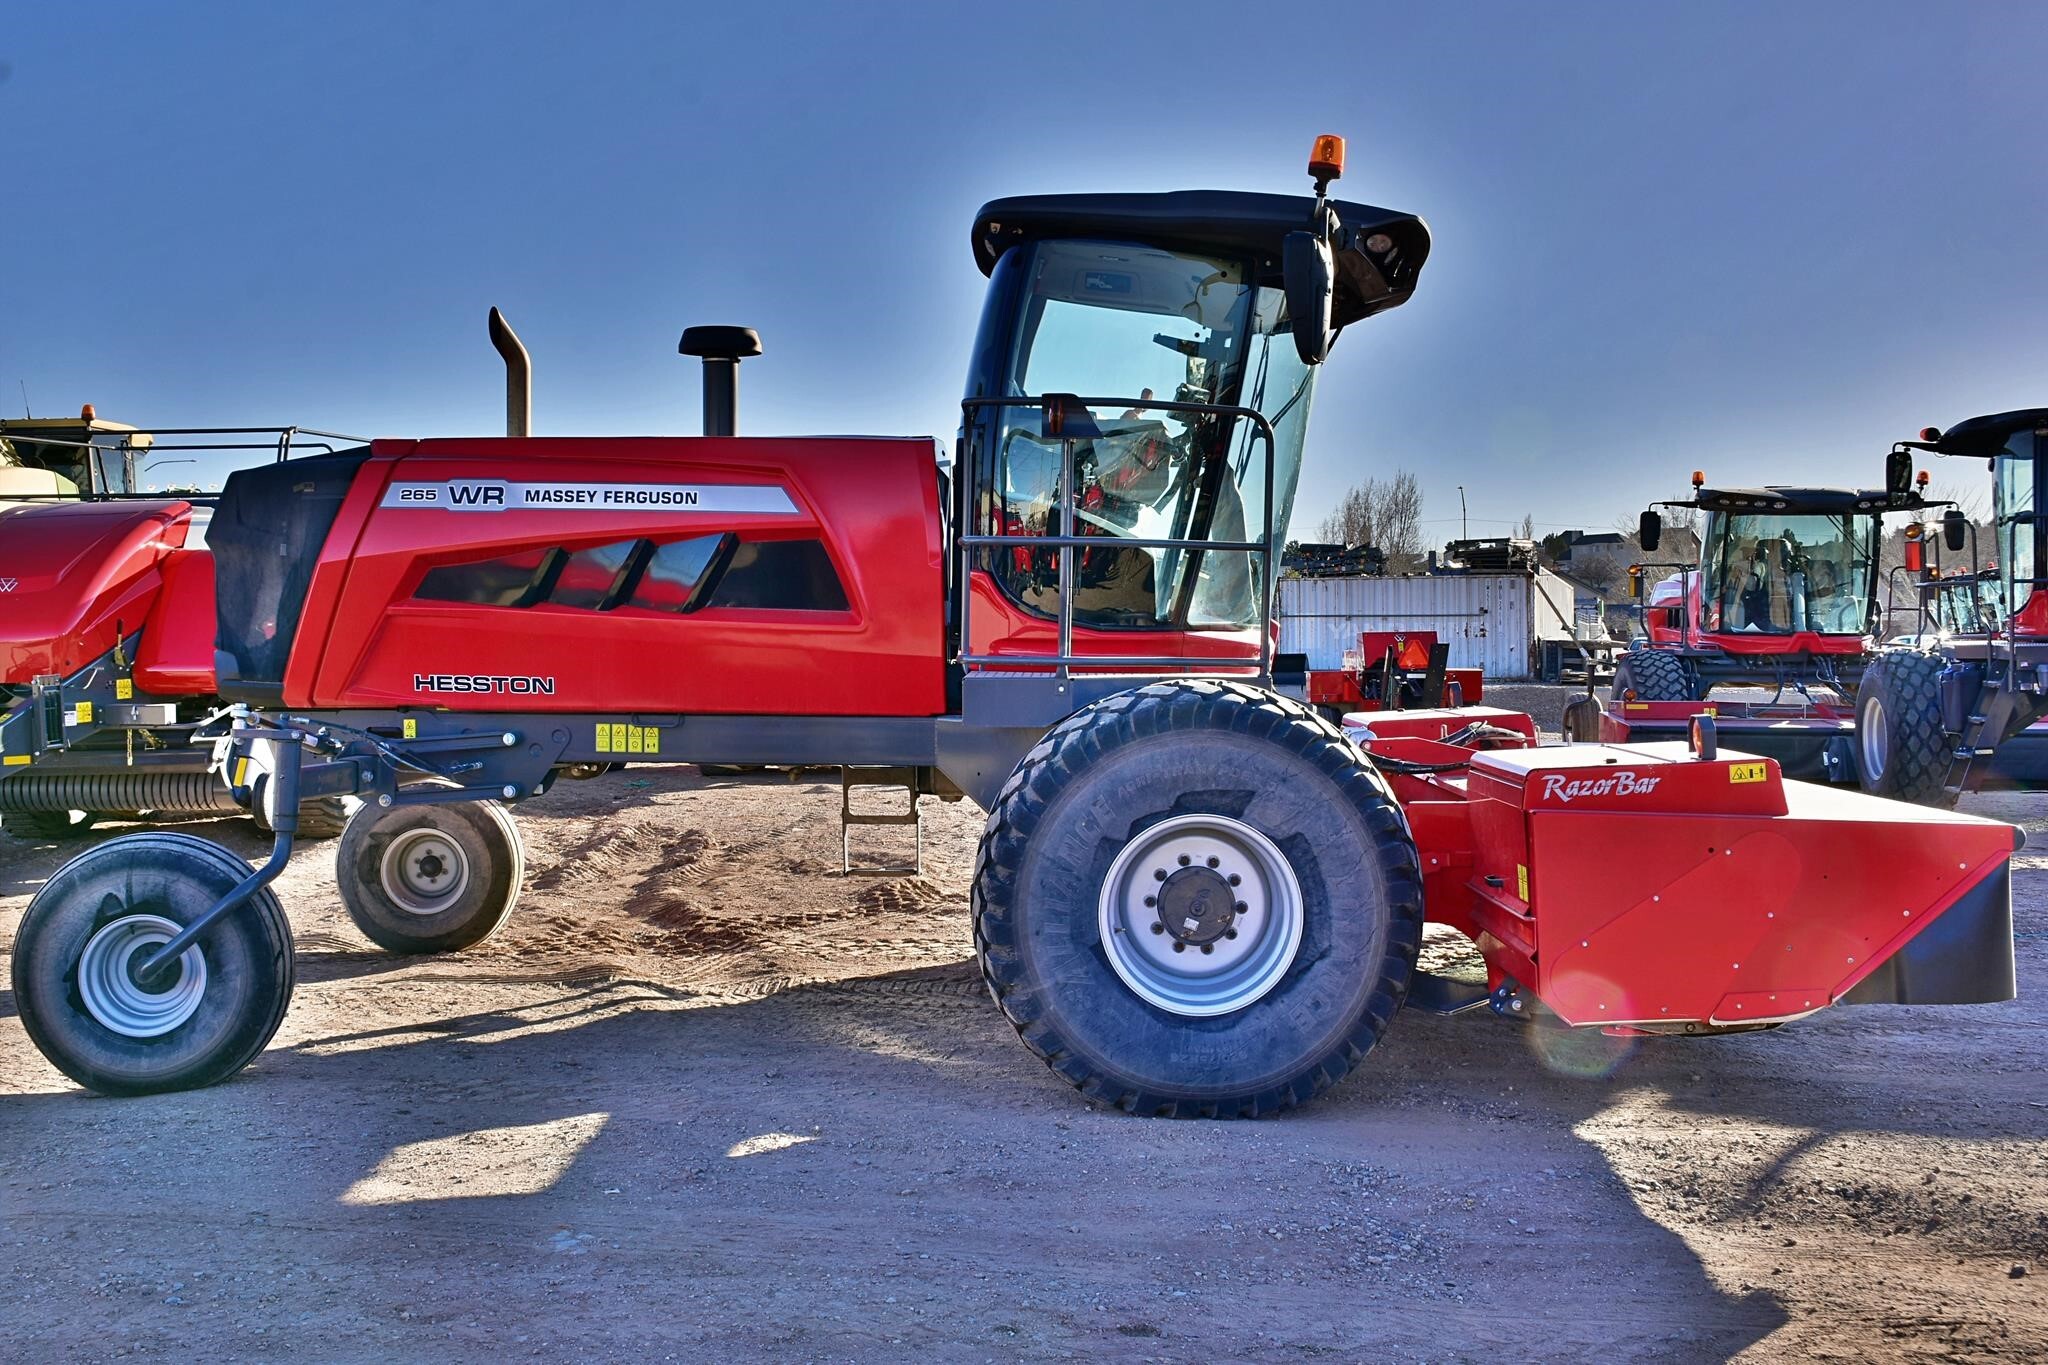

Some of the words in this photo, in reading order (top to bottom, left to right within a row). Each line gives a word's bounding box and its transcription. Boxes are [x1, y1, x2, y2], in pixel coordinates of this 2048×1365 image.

[400, 488, 438, 501] 265
[448, 485, 505, 505] WR
[524, 489, 597, 504] MASSEY
[603, 490, 699, 505] FERGUSON
[413, 673, 555, 695] HESSTON
